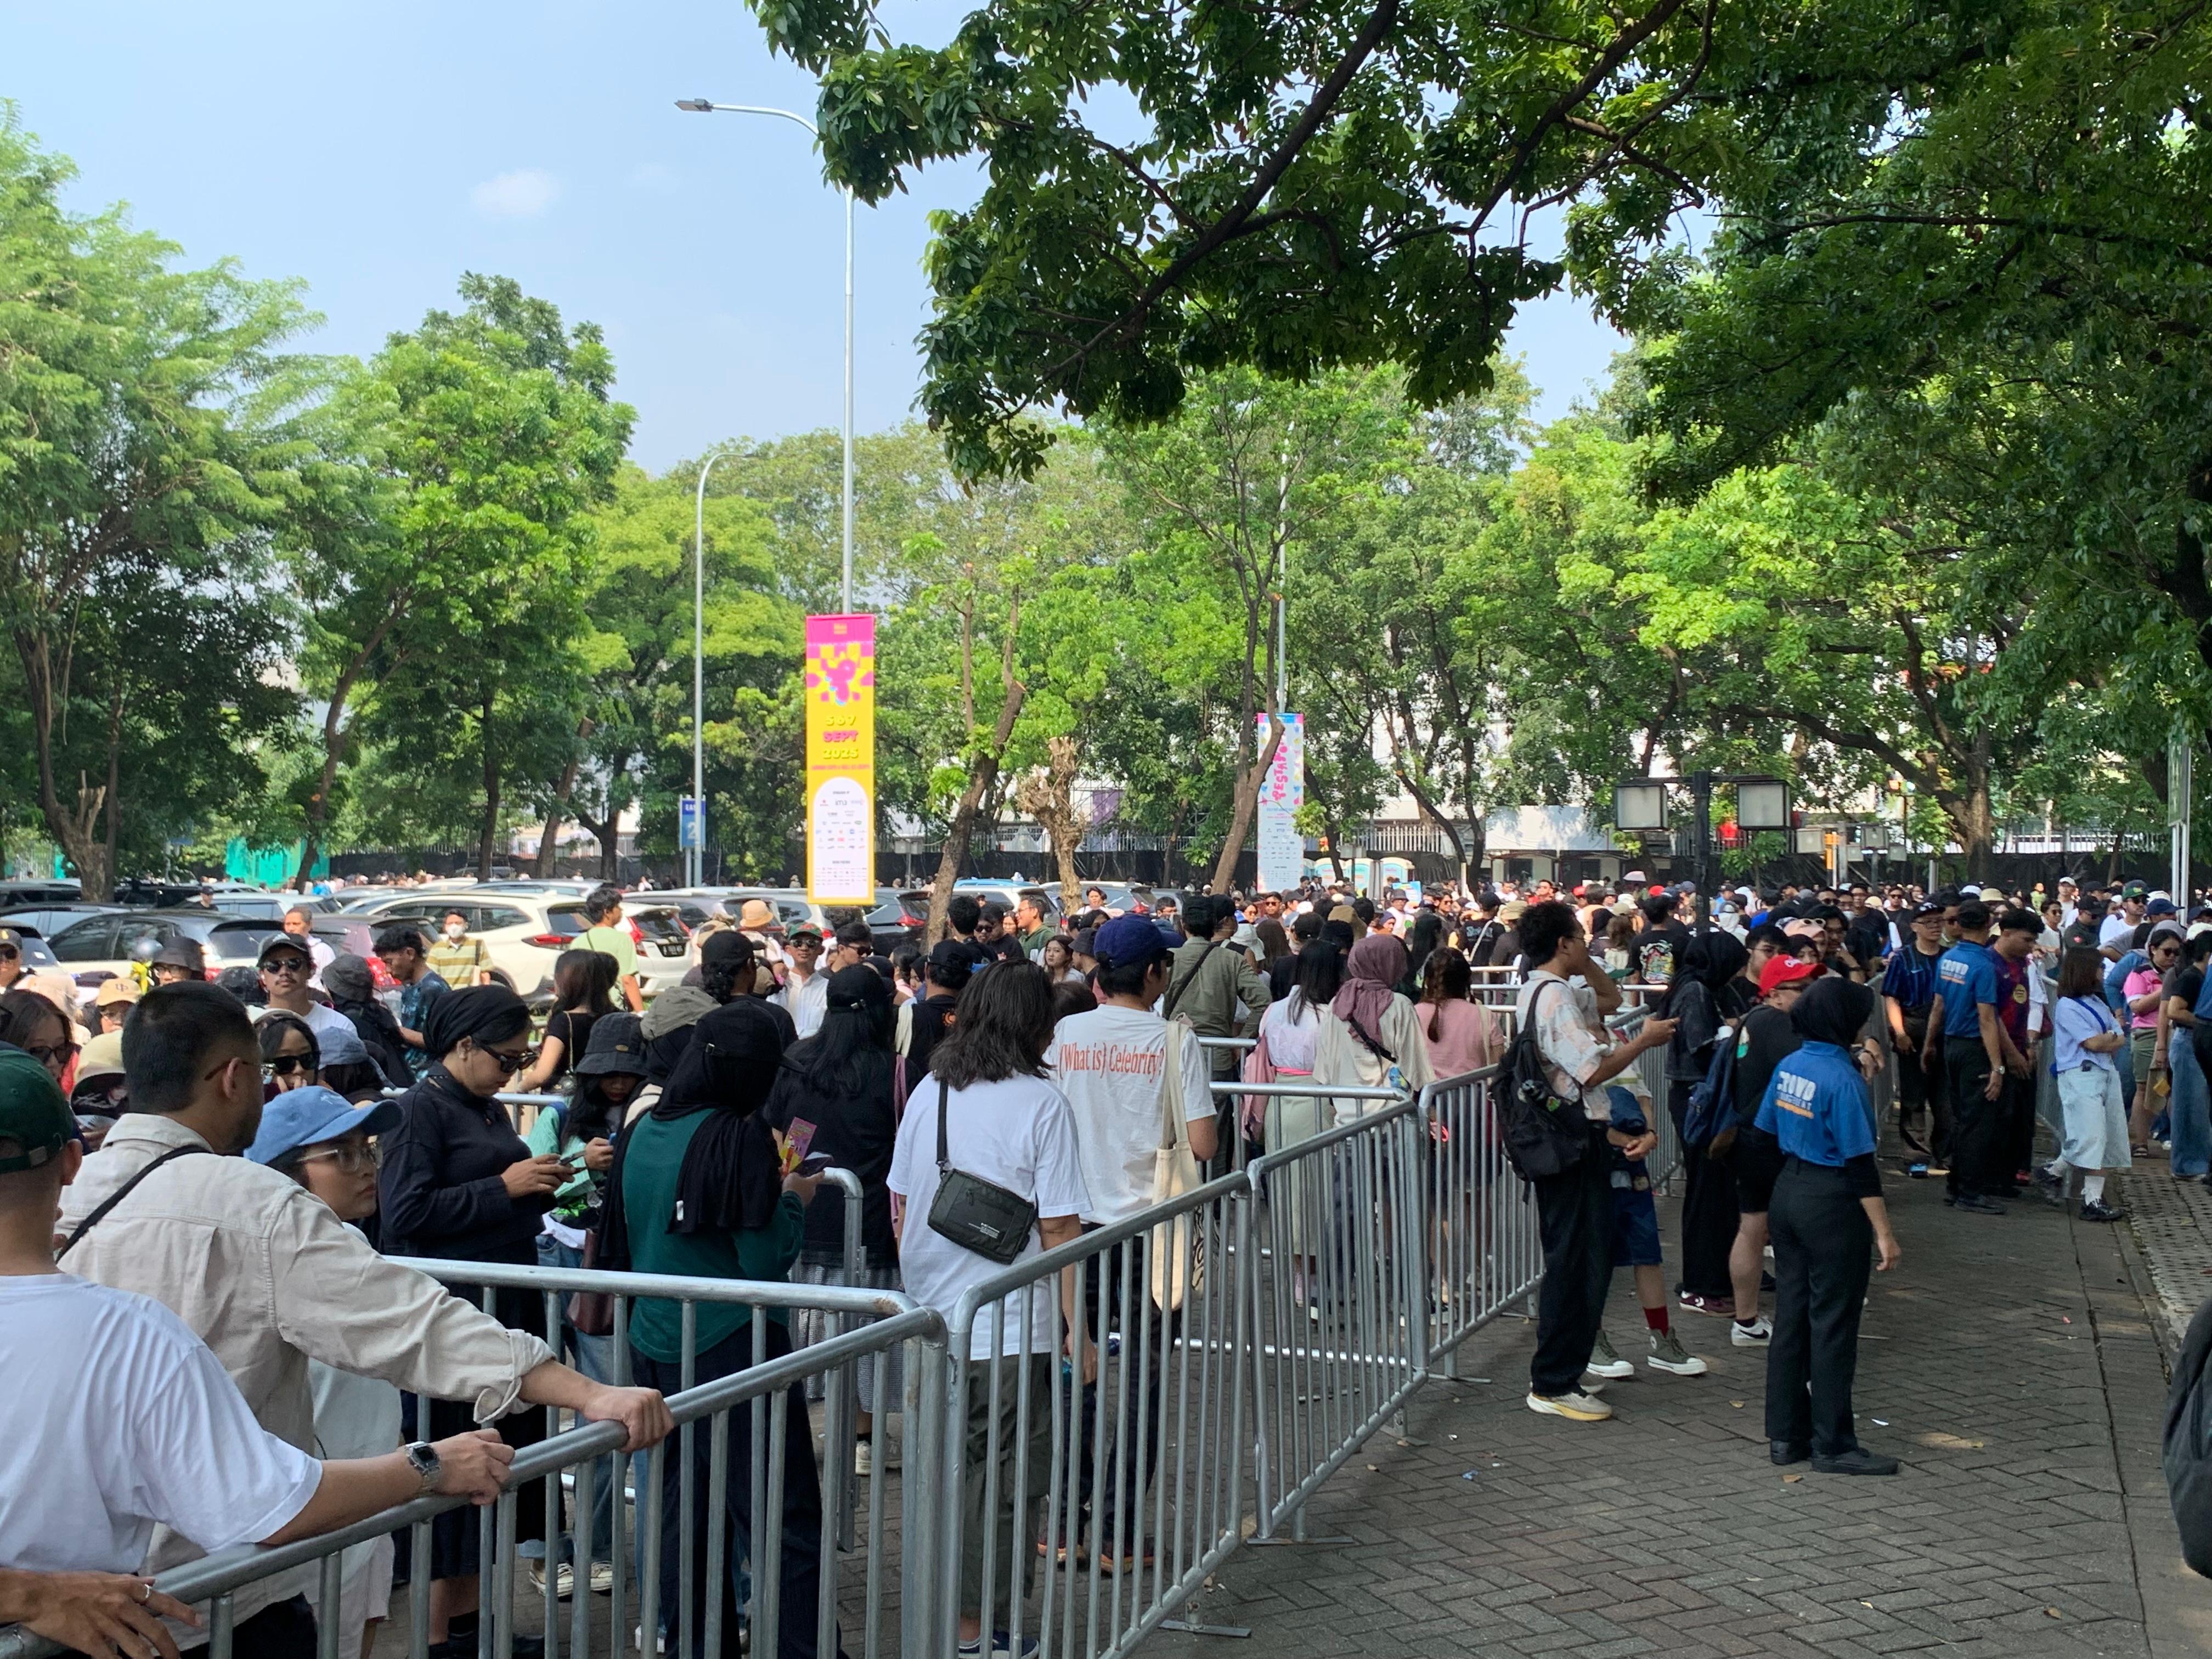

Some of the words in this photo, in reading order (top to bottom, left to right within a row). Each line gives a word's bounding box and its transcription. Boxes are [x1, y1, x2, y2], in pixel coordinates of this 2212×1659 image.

[823, 730, 859, 743] SEPT
[823, 748, 859, 760] 2025
[1272, 732, 1289, 801] PESTAPO
[1059, 1042, 1090, 1080] (What
[1092, 1042, 1107, 1079] is)
[1109, 1044, 1165, 1084] Celebrity?
